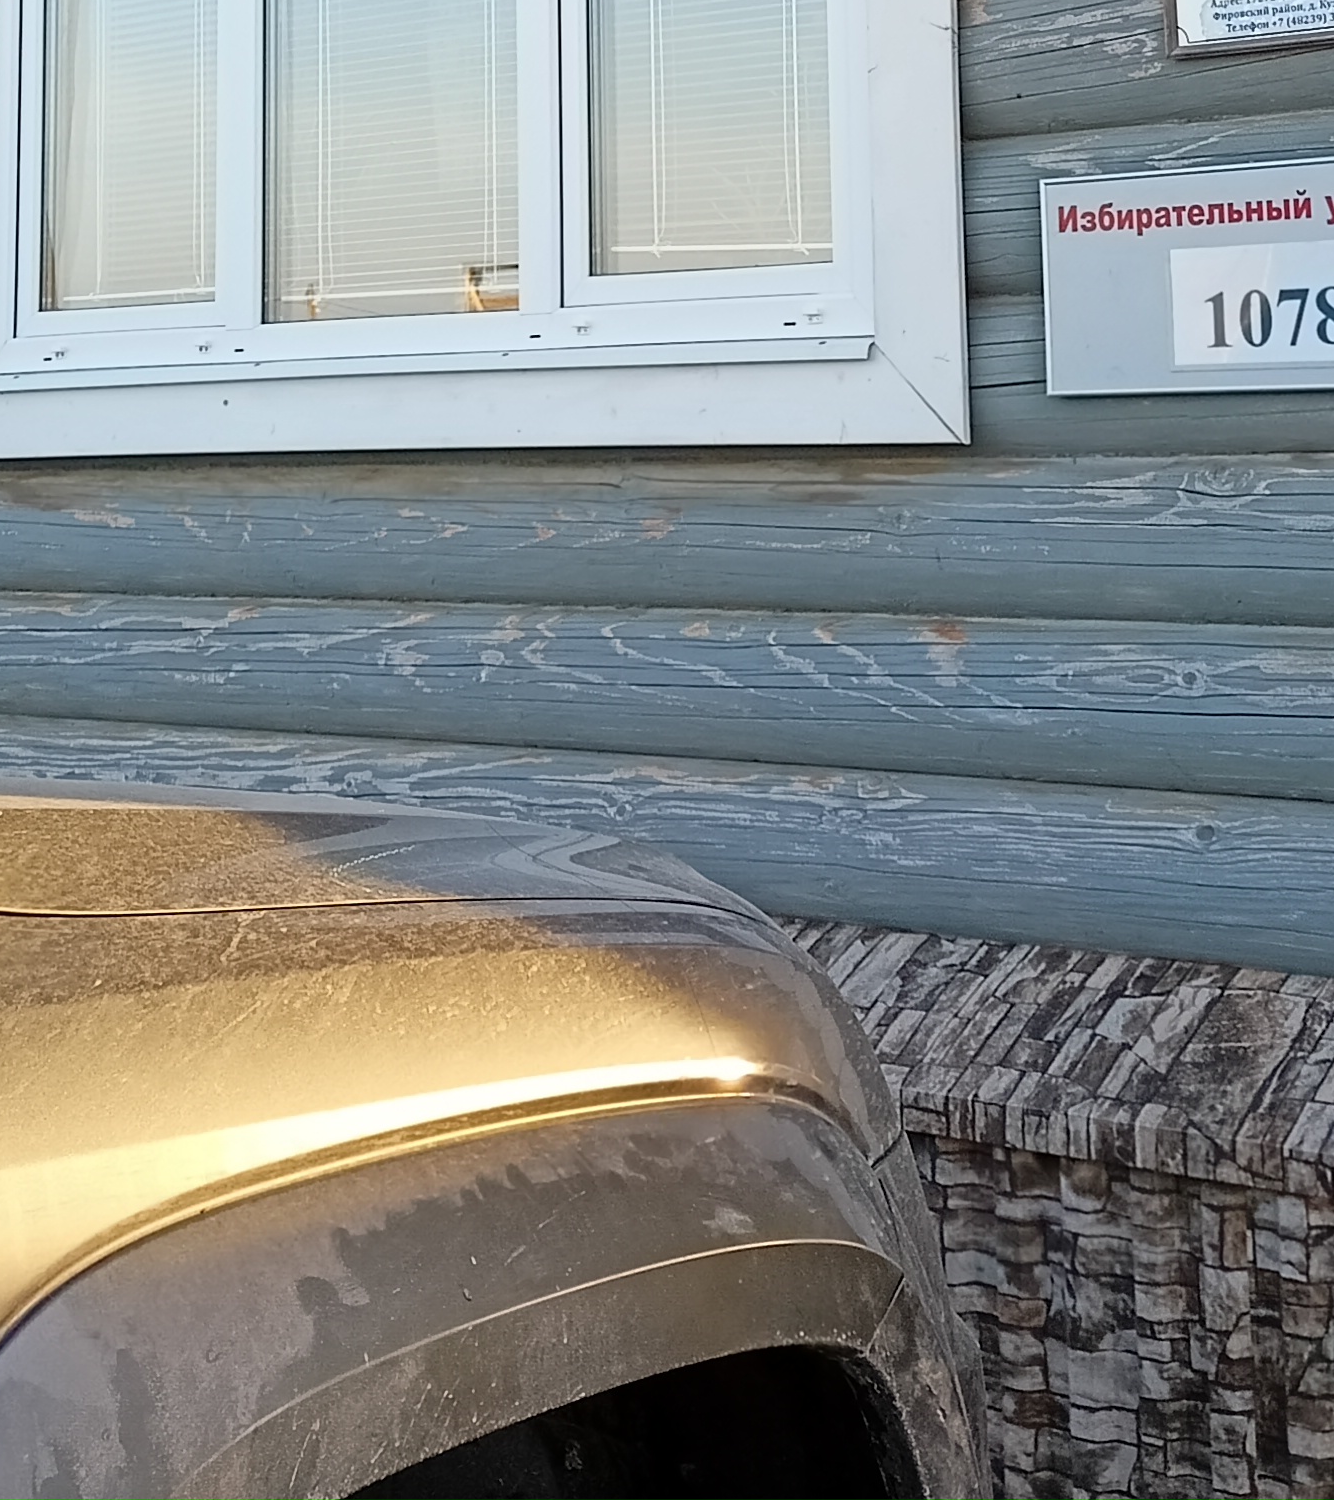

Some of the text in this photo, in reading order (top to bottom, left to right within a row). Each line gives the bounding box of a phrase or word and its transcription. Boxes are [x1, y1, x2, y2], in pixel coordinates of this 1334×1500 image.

[1212, 6, 1270, 22] Фировский
[1225, 18, 1270, 34] Телефон
[1271, 17, 1284, 28] +7
[1286, 13, 1328, 29] (48239)
[1057, 188, 1314, 237] Избирательный
